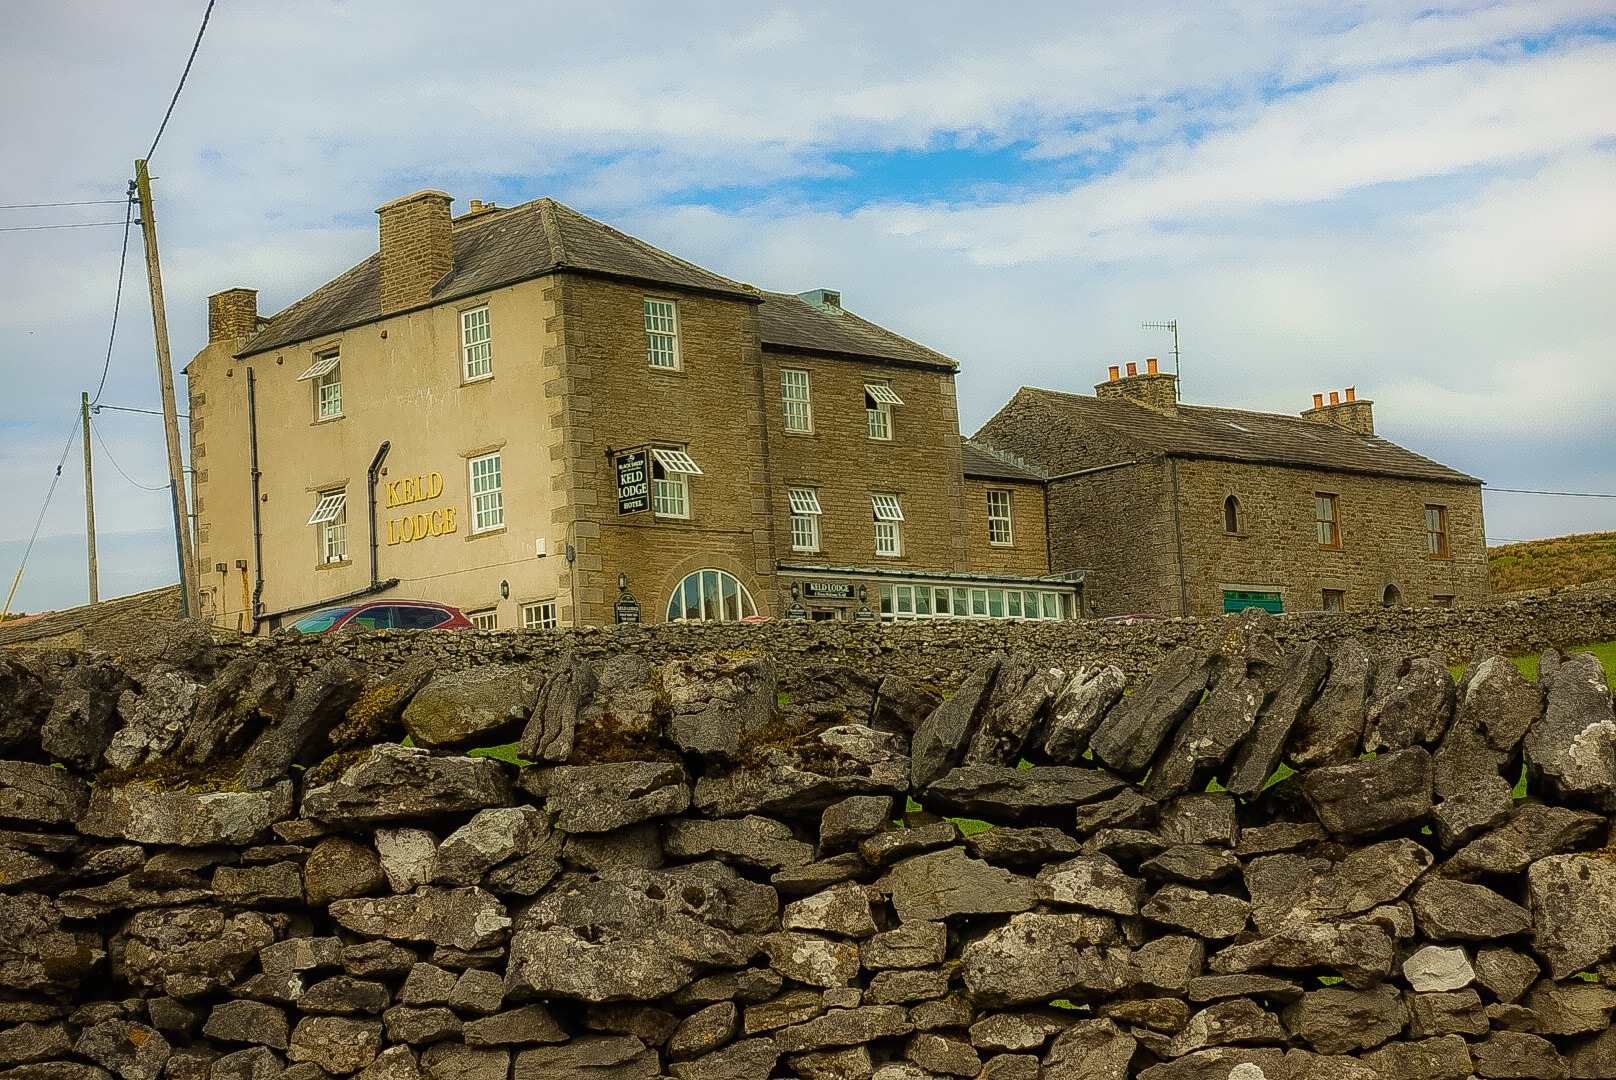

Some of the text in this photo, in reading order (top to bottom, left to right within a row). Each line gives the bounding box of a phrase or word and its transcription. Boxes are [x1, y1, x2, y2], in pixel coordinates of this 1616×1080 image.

[621, 471, 643, 485] KELD
[385, 472, 443, 508] KELD
[618, 483, 647, 498] LODGE
[624, 500, 643, 509] HOTEL
[386, 506, 457, 546] LODGE
[810, 583, 850, 592] KELD LODGE
